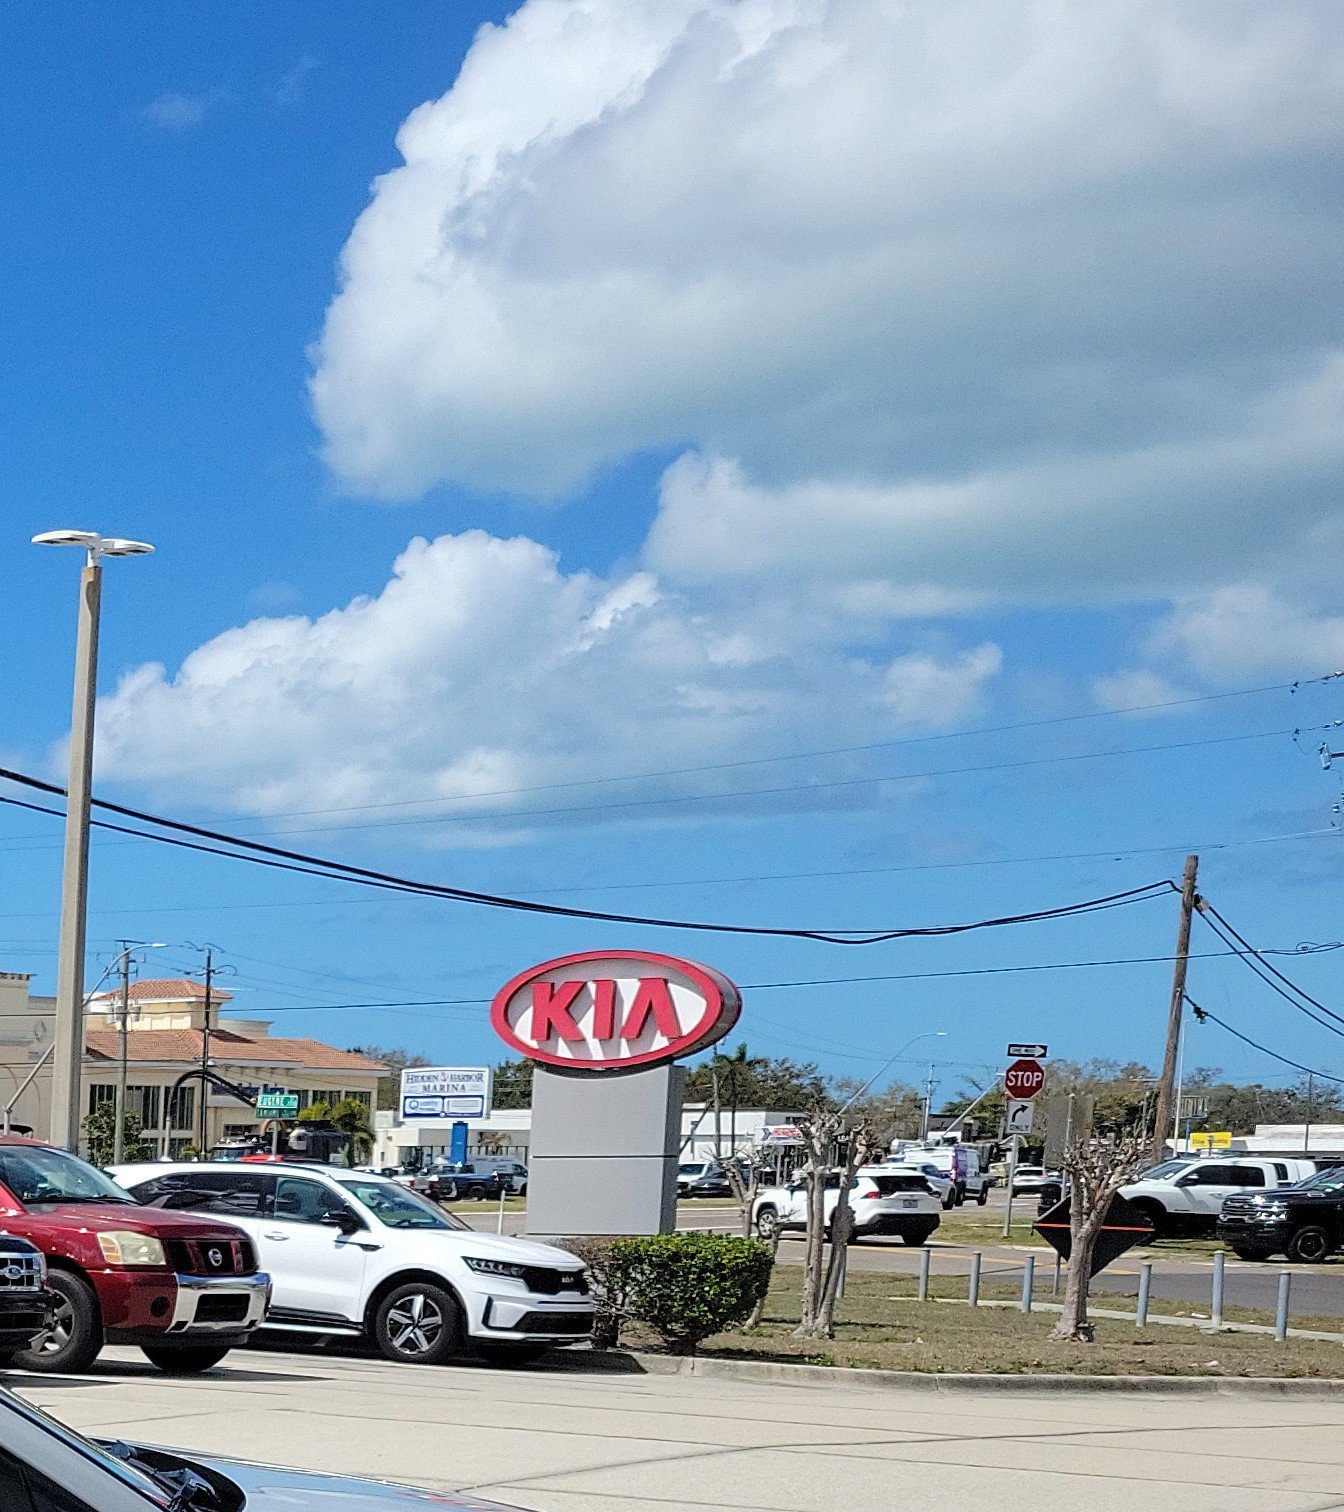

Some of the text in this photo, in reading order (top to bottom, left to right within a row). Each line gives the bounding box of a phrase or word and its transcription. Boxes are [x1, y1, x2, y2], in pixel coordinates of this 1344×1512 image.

[530, 977, 683, 1042] KIA
[1007, 1071, 1042, 1087] STOP
[422, 1084, 466, 1092] MARINA
